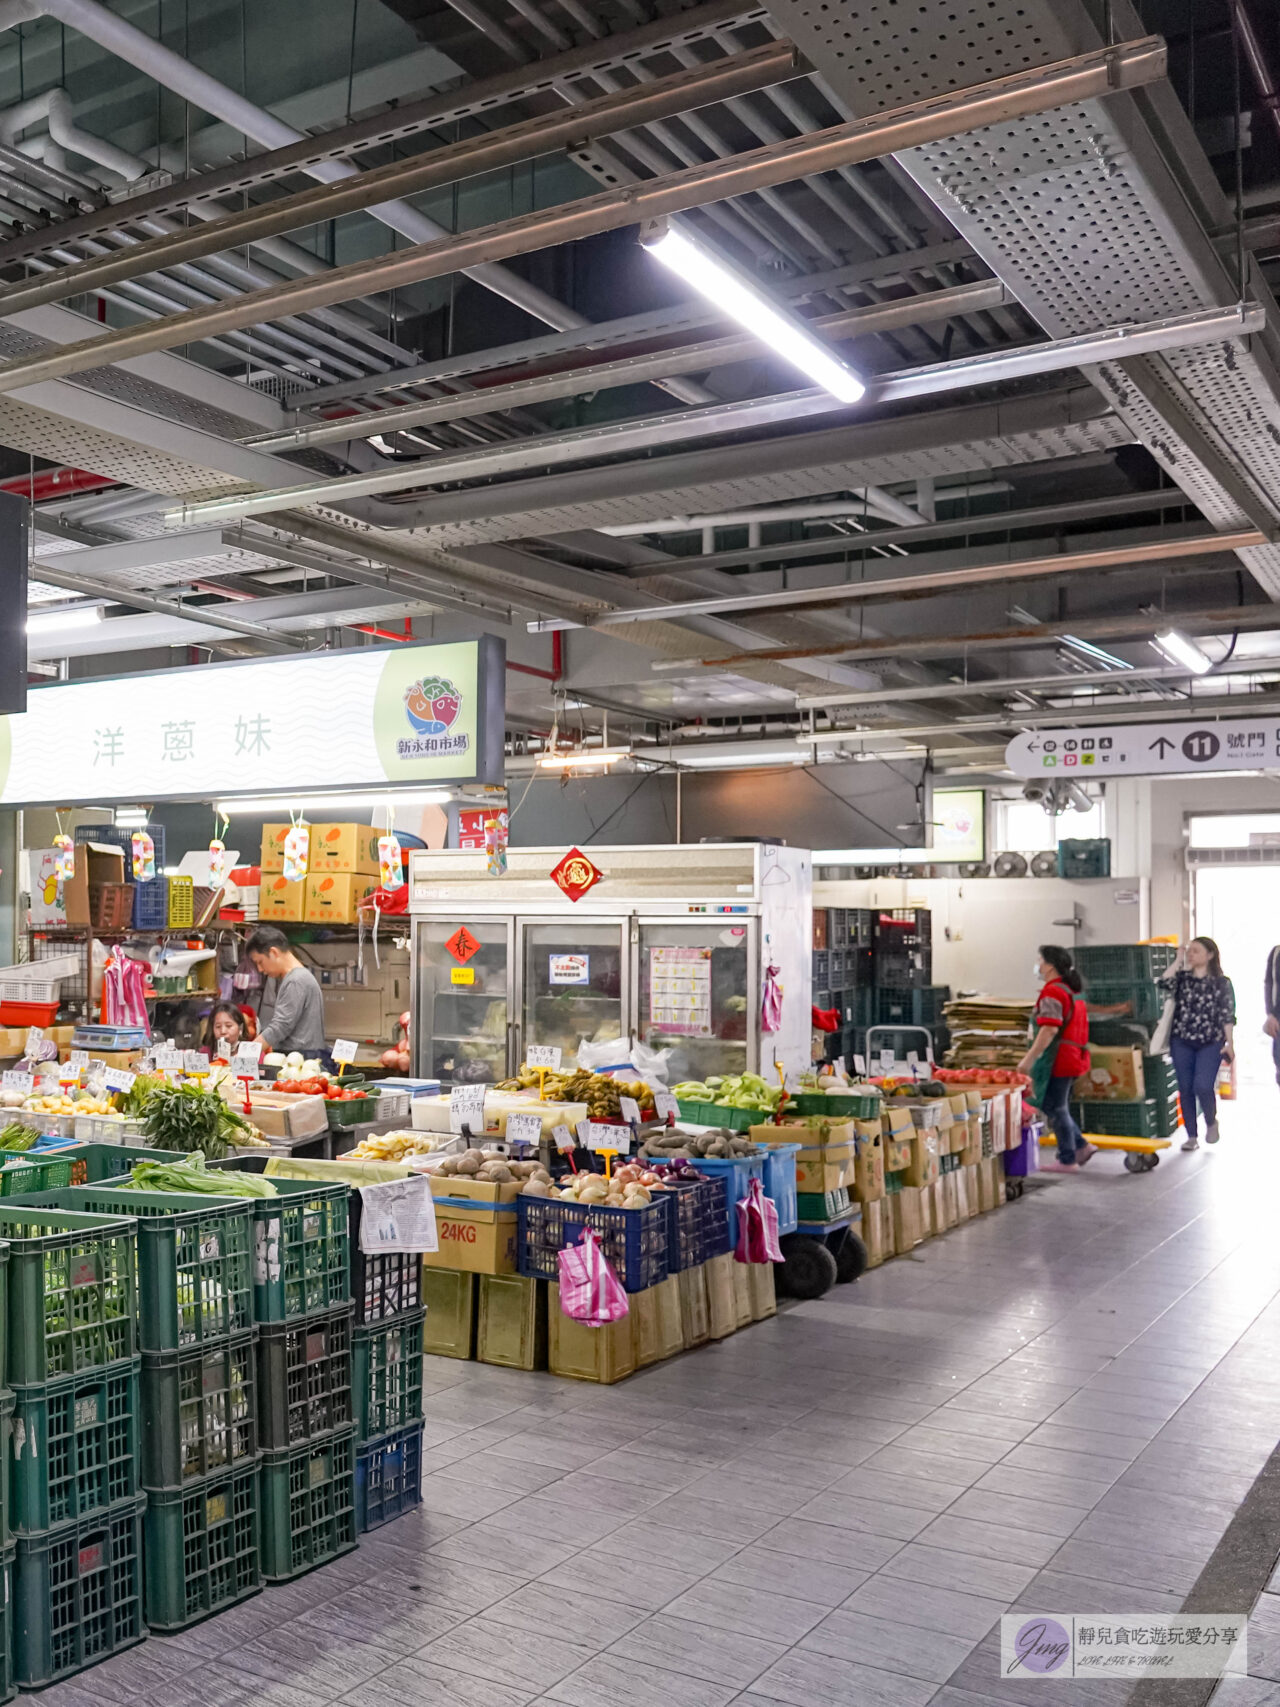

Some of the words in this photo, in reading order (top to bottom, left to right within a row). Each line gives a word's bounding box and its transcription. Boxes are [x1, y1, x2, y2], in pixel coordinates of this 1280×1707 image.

[93, 713, 272, 767] 洋蔥妹
[398, 735, 467, 754] 新永和市場
[1188, 737, 1212, 756] 11
[1226, 732, 1265, 749] 號門
[454, 929, 472, 957] 春
[440, 1222, 477, 1244] 24KG
